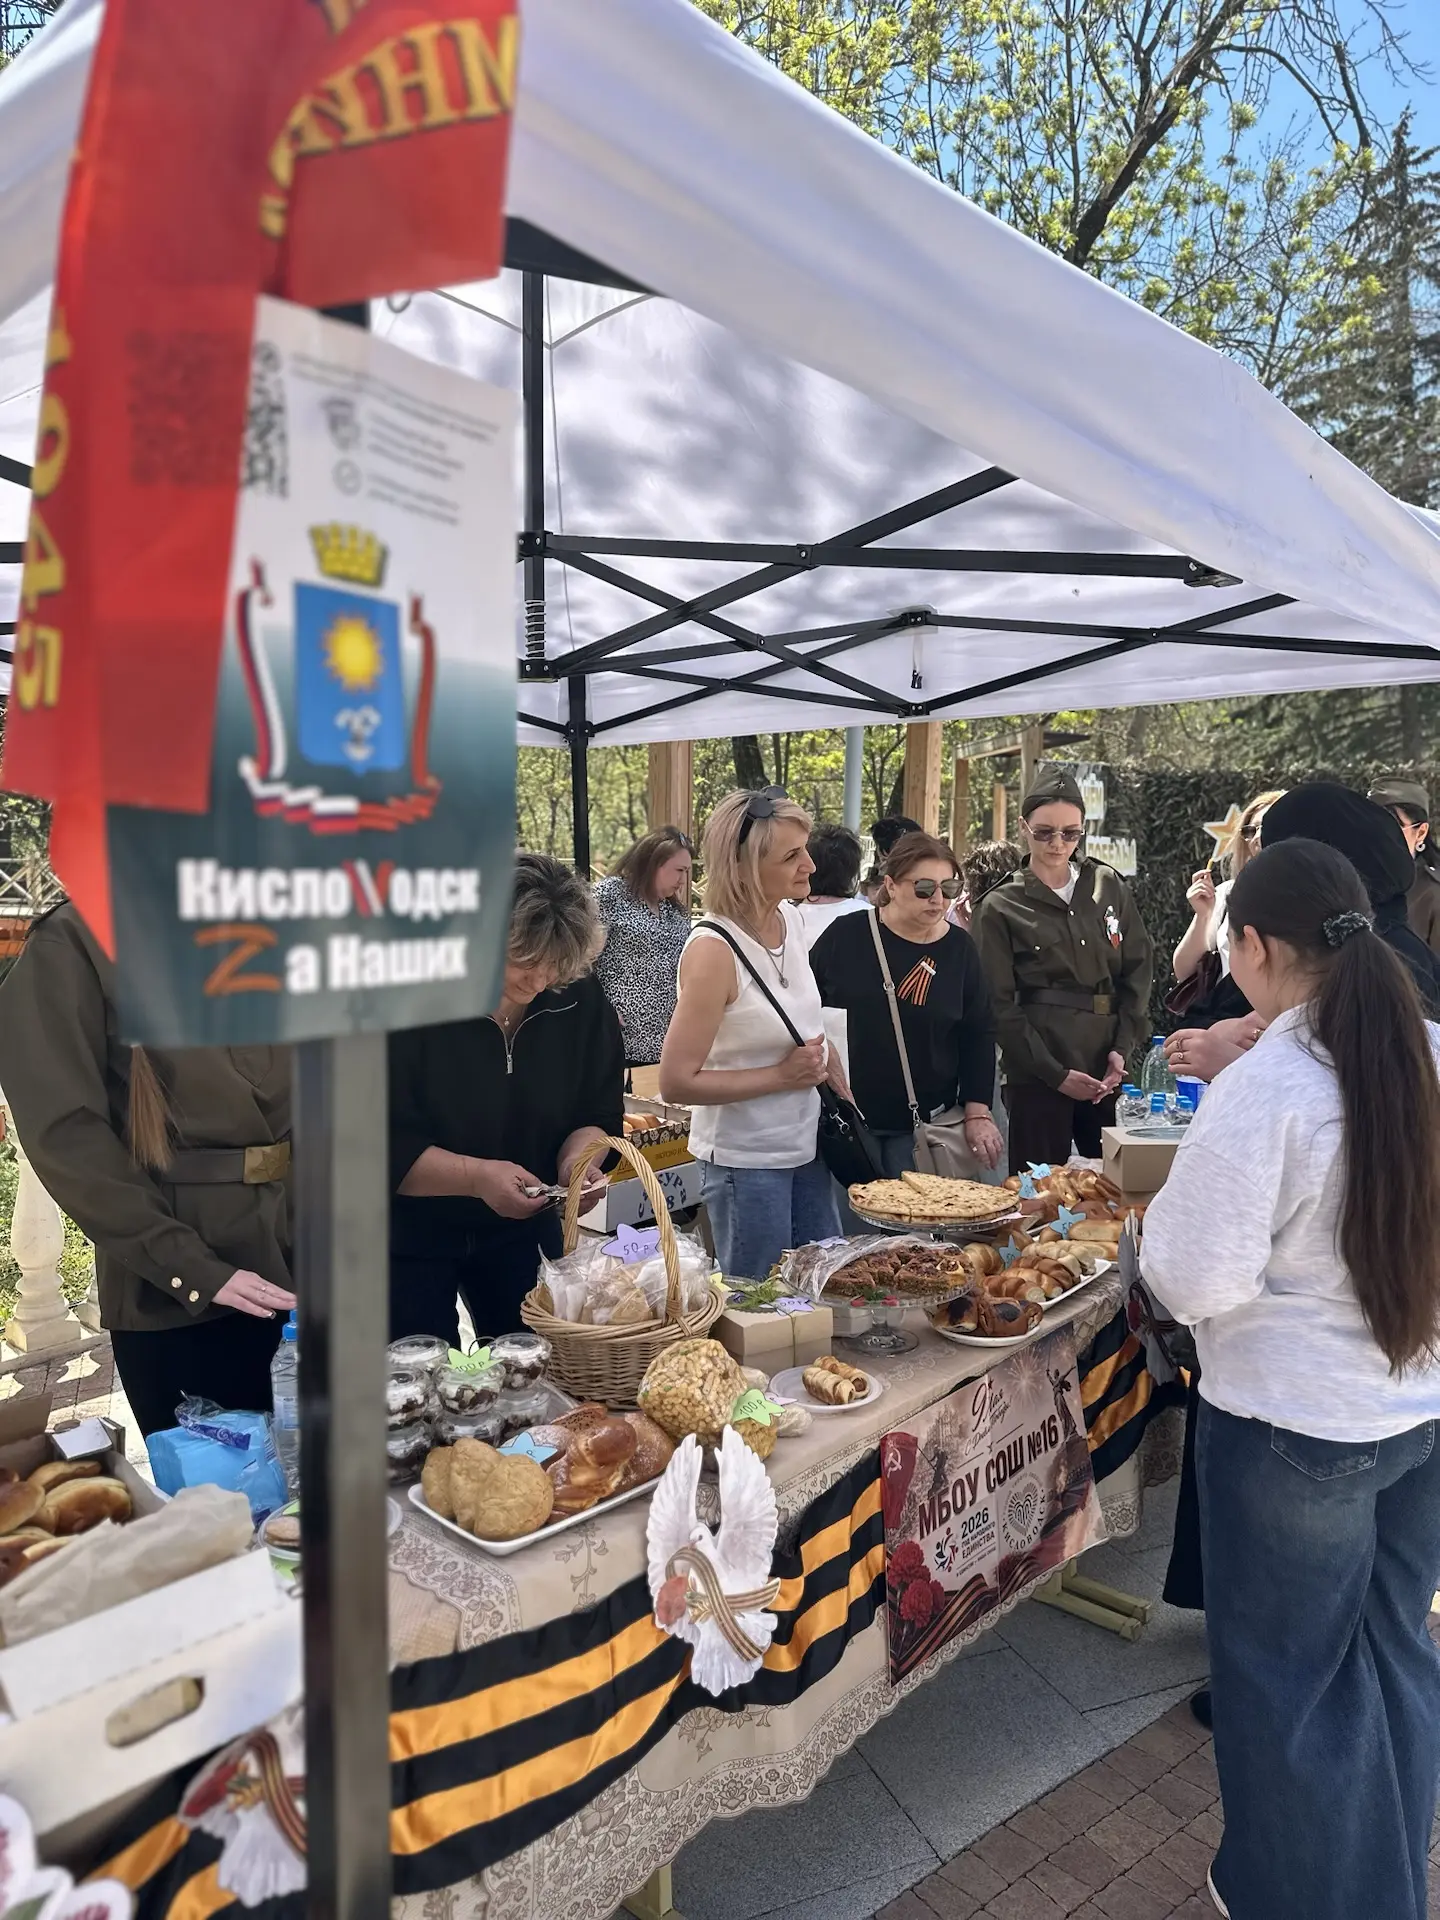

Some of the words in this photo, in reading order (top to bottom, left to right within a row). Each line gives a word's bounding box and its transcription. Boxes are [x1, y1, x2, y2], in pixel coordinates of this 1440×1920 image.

[328, 933, 468, 991] Наших
[623, 1242, 639, 1255] 50
[456, 1363, 476, 1372] 100
[740, 1401, 758, 1416] 100
[972, 1383, 987, 1432] 9
[919, 1466, 980, 1541] МБОУ
[985, 1436, 1025, 1494] СОШ
[1027, 1414, 1060, 1464] №16
[961, 1507, 989, 1539] 2026
[962, 1530, 996, 1559] ЕДИНСТВА
